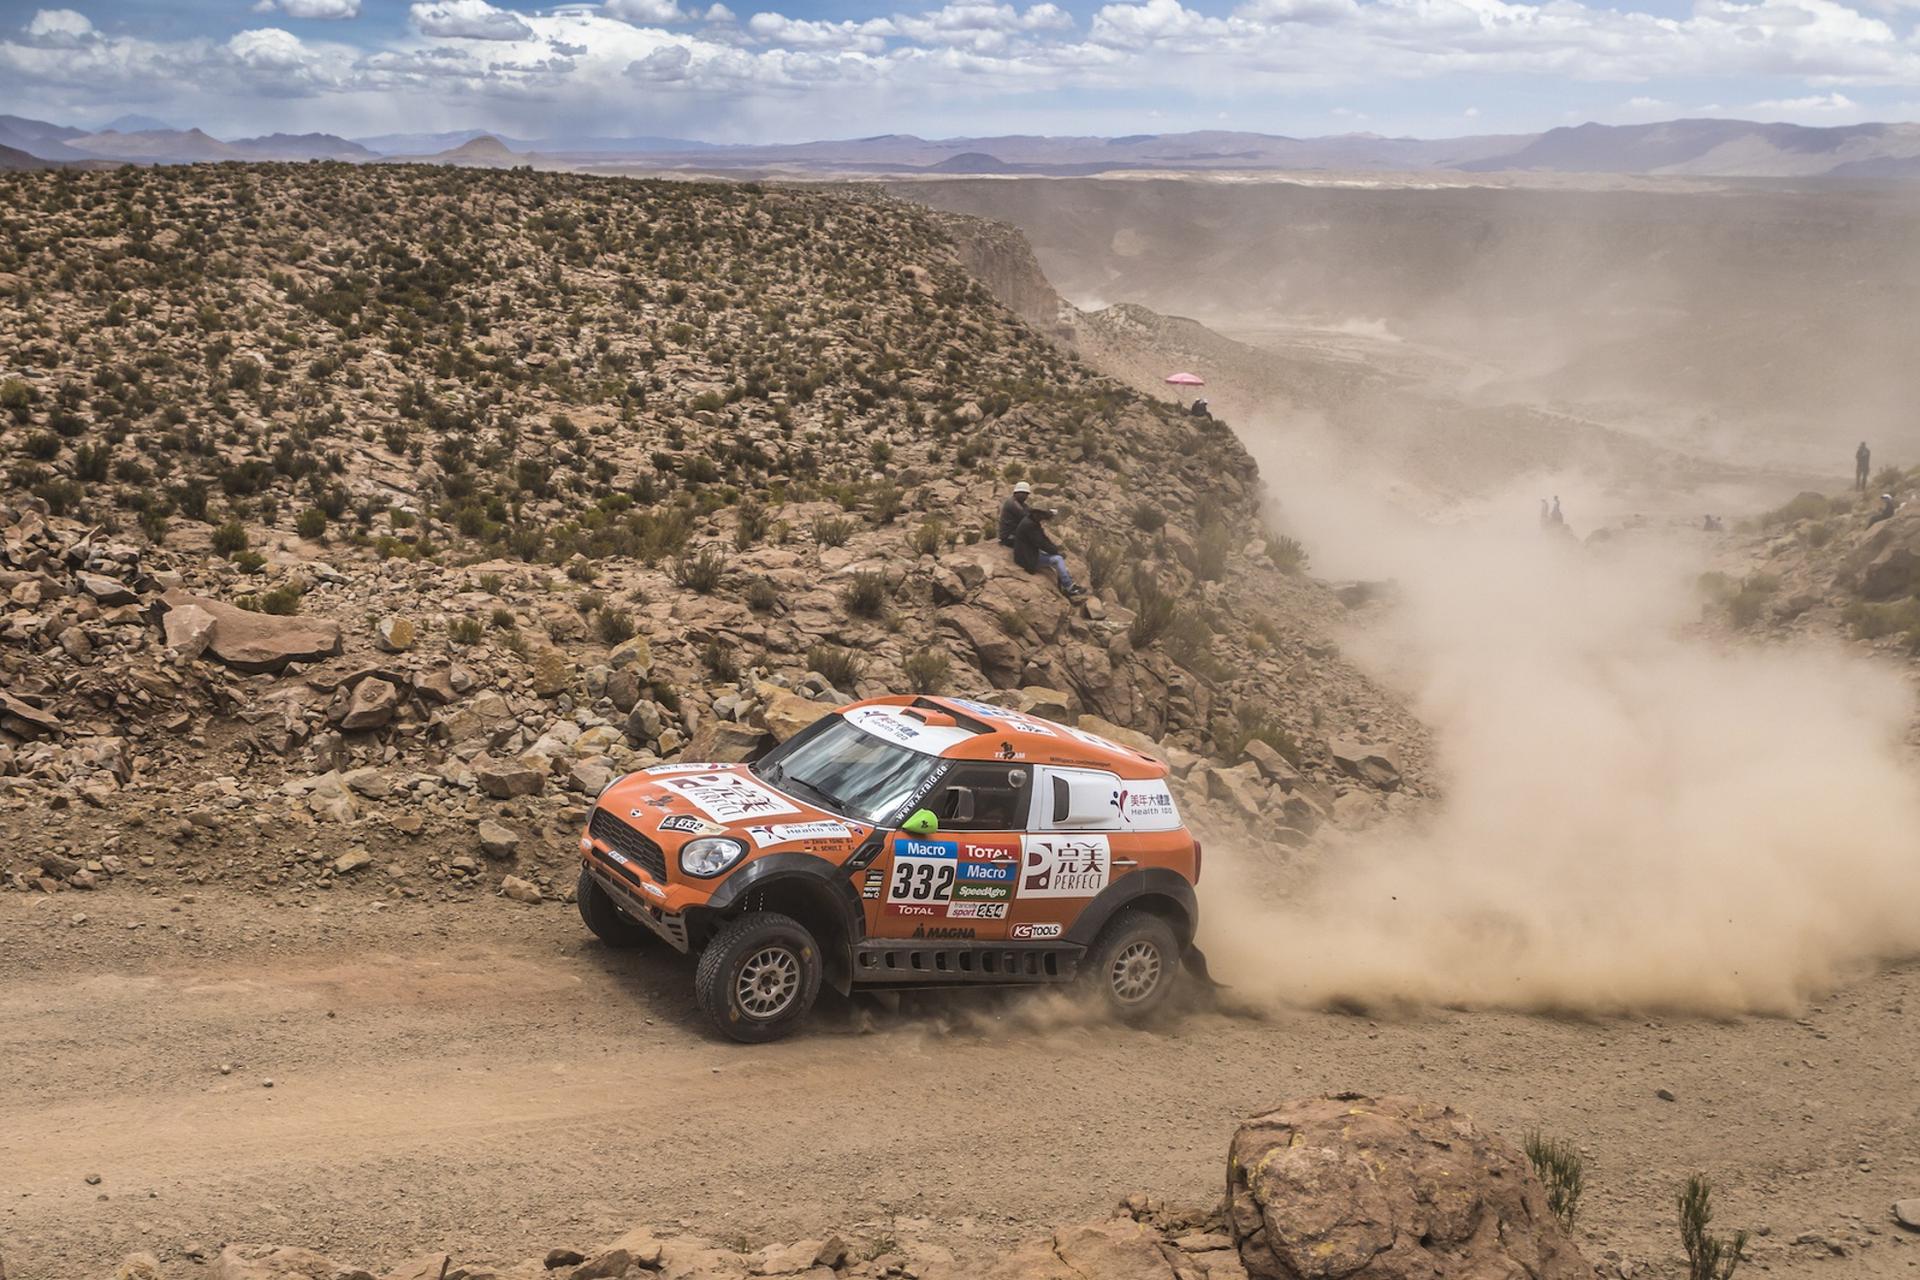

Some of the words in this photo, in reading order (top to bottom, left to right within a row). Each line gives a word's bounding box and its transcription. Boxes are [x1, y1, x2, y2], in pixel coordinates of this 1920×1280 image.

[678, 819, 704, 831] 332
[907, 842, 946, 856] Macro
[965, 844, 1012, 859] TOTAL
[1057, 842, 1104, 874] 完美
[967, 864, 1007, 879] Macro
[892, 862, 955, 901] 332
[1054, 874, 1103, 890] PERFECT
[959, 886, 1007, 898] SpeedAgro
[898, 904, 935, 916] TOTAL
[952, 908, 976, 917] sport
[926, 927, 976, 939] MAGNA
[1013, 926, 1033, 938] KS
[1032, 926, 1058, 936] TOOLS
